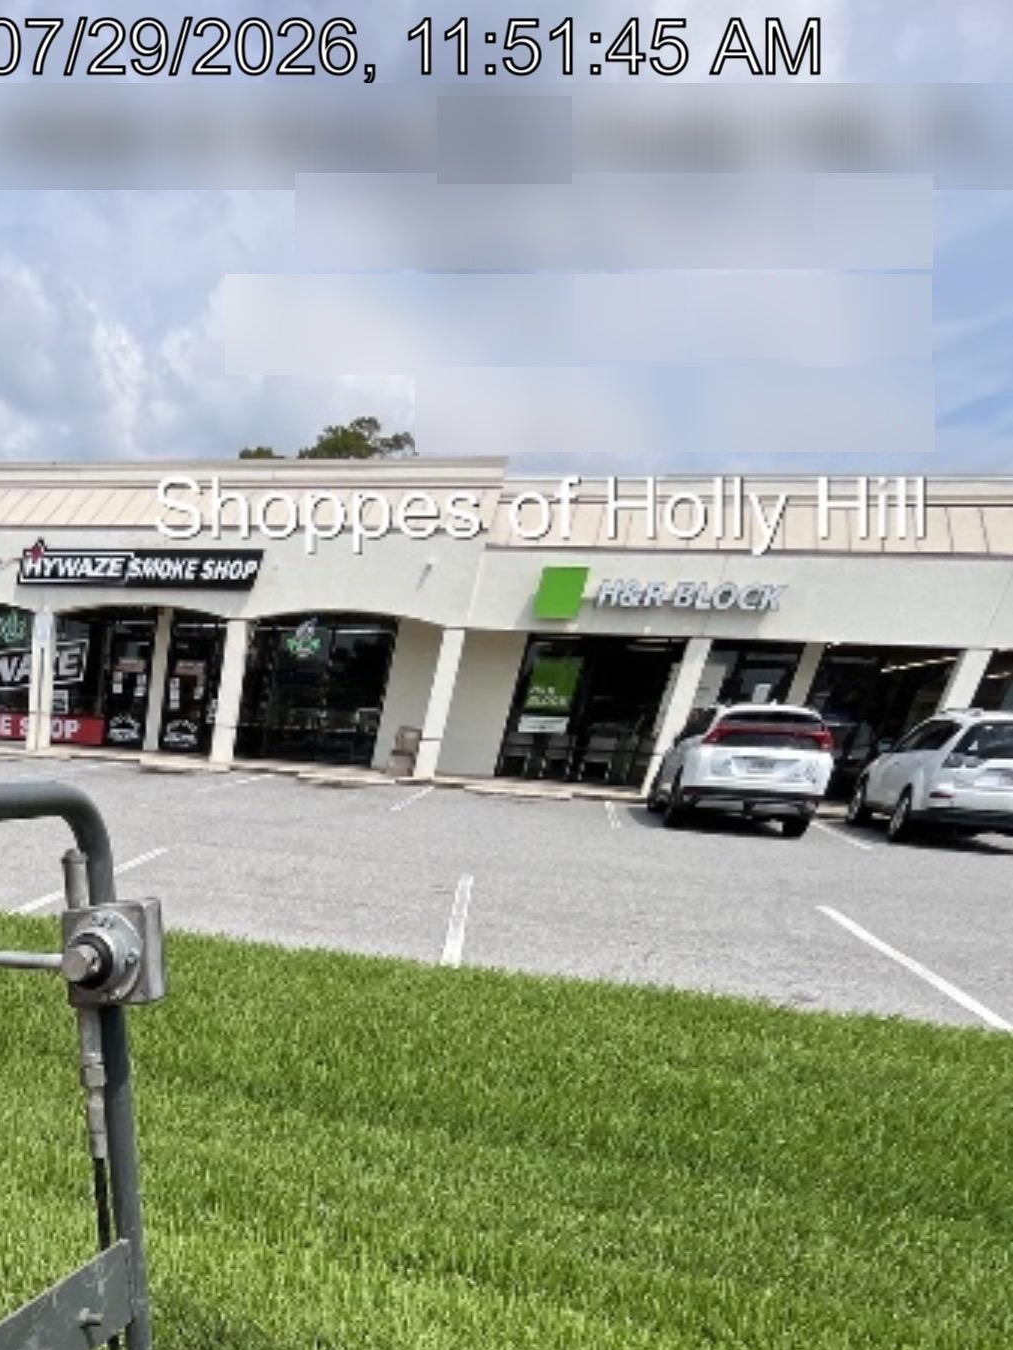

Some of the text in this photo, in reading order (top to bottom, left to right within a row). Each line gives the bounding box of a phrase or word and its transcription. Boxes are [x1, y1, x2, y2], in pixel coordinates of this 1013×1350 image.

[23, 555, 258, 580] HYWAZE SMOKE SHOP
[596, 579, 788, 611] H&R BLOCK
[19, 716, 81, 739] SOP
